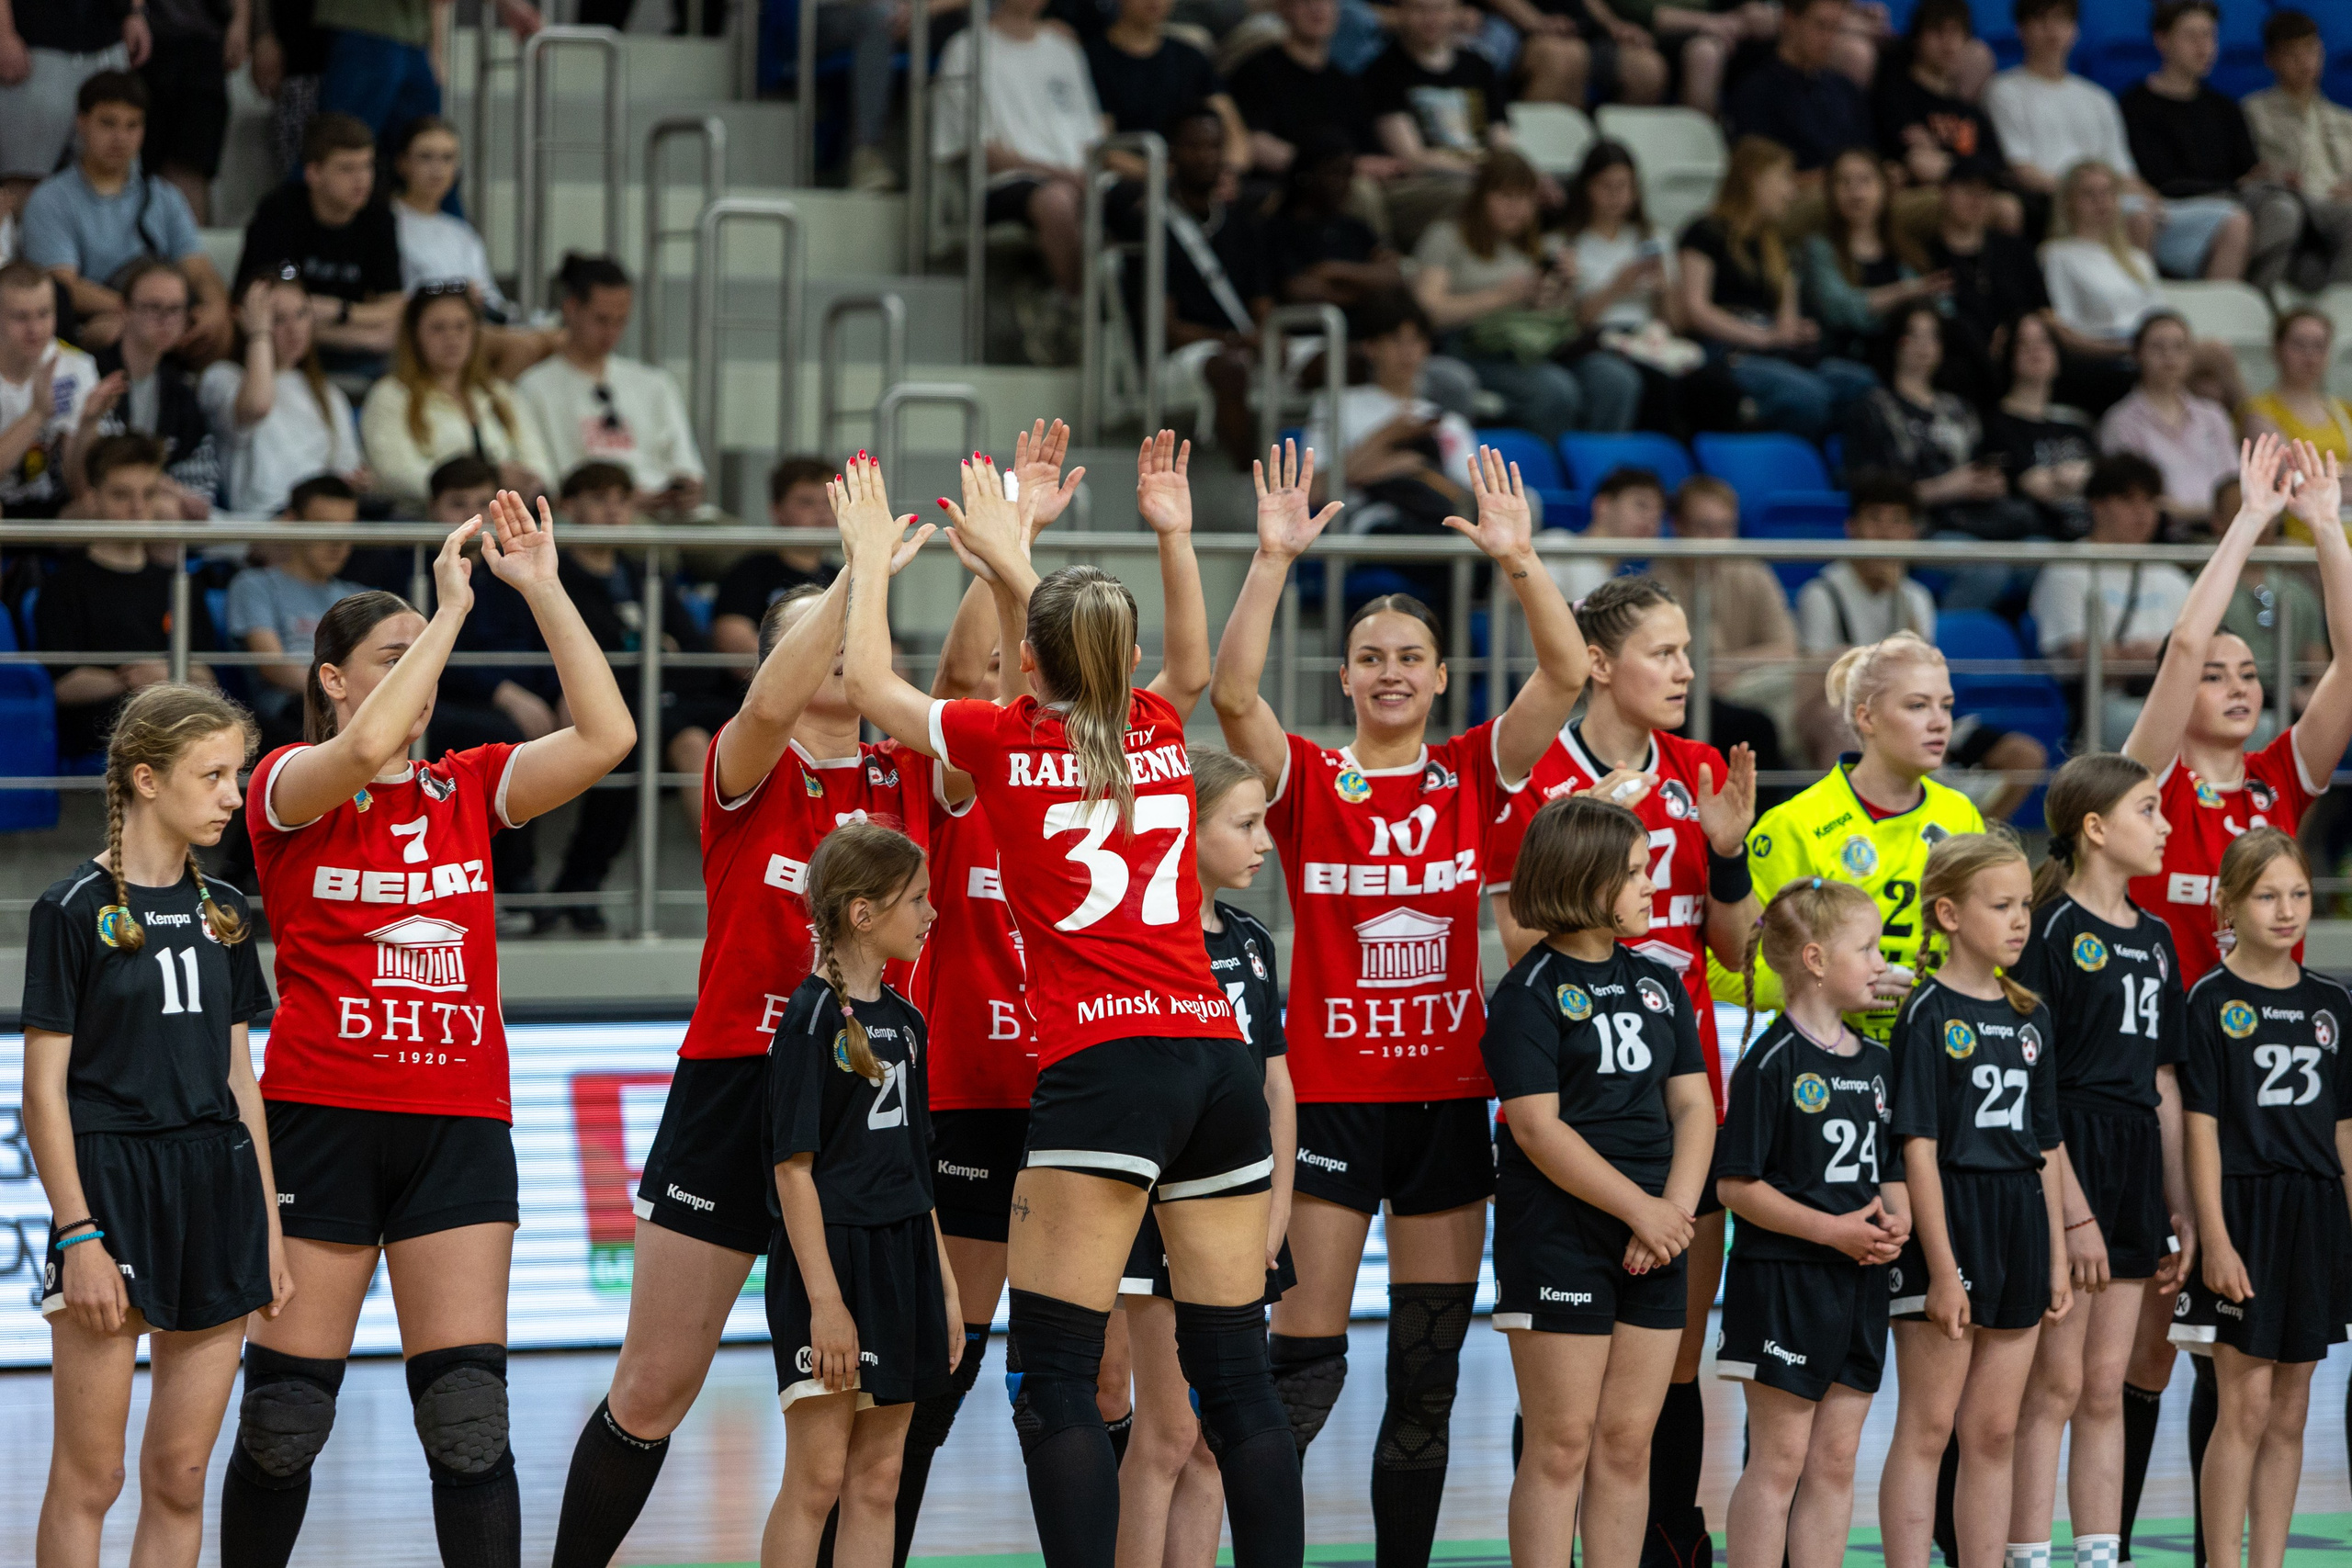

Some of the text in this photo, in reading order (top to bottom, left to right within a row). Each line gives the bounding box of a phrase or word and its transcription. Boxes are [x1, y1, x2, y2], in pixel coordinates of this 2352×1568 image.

[1009, 743, 1192, 786] RAHENKA
[390, 815, 428, 863] 7
[1368, 804, 1437, 856] 10
[1814, 812, 1853, 839] Kempa
[1044, 794, 1190, 931] 37
[1304, 848, 1477, 896] BELAZ
[312, 860, 489, 905] BELAZ
[144, 911, 191, 928] Kempa
[1649, 895, 1705, 928] LAZ
[154, 946, 203, 1014] 11
[338, 997, 485, 1046] БНТУ
[1078, 989, 1160, 1024] Minsk
[1324, 988, 1472, 1039] БНТУ
[2120, 973, 2161, 1040] 14
[2261, 1006, 2305, 1023] Kempa
[865, 1025, 898, 1041] Kempa
[1591, 1012, 1652, 1073] 18
[1977, 1021, 2014, 1040] Kempa
[398, 1052, 447, 1066] 1920
[1382, 1044, 1429, 1057] 1920
[1830, 1077, 1870, 1094] Kempa
[2253, 1043, 2323, 1107] 23
[867, 1060, 909, 1130] 21
[1972, 1064, 2029, 1131] 27
[937, 1159, 989, 1180] Kempa
[1296, 1147, 1348, 1172] Kempa
[1822, 1118, 1880, 1183] 24
[666, 1183, 715, 1212] Kempa
[1539, 1287, 1592, 1305] Kempa
[1762, 1339, 1807, 1366] Kempa
